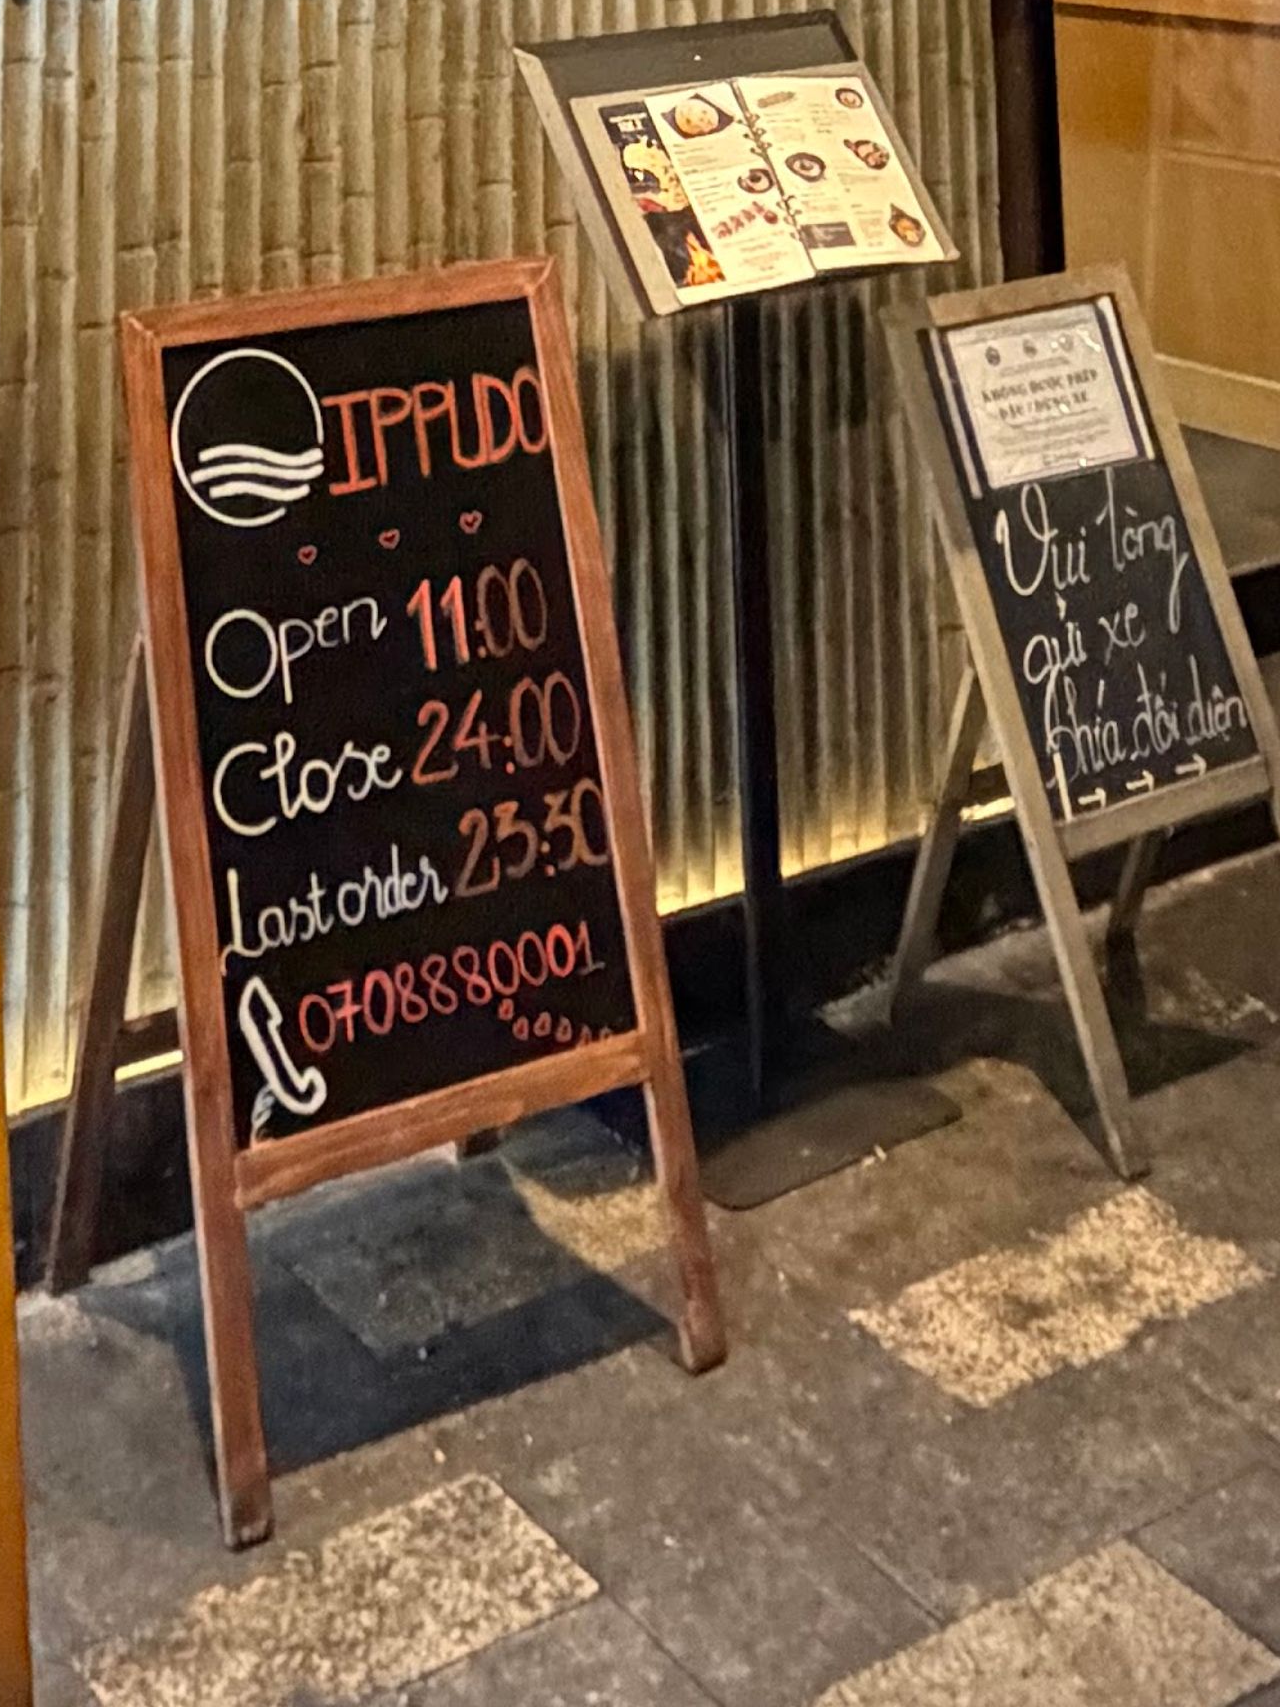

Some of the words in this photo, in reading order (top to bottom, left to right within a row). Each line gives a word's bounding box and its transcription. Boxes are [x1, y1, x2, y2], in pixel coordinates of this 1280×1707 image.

[320, 365, 550, 496] IPPUDO
[995, 482, 1091, 597] Vui
[1096, 467, 1189, 634] lòng
[205, 596, 387, 704] Open
[1098, 601, 1147, 666] xe
[1130, 661, 1181, 761] đối
[1185, 653, 1248, 747] diện
[214, 731, 403, 837] Close
[337, 843, 448, 926] order
[297, 920, 606, 1052] 0708880001
